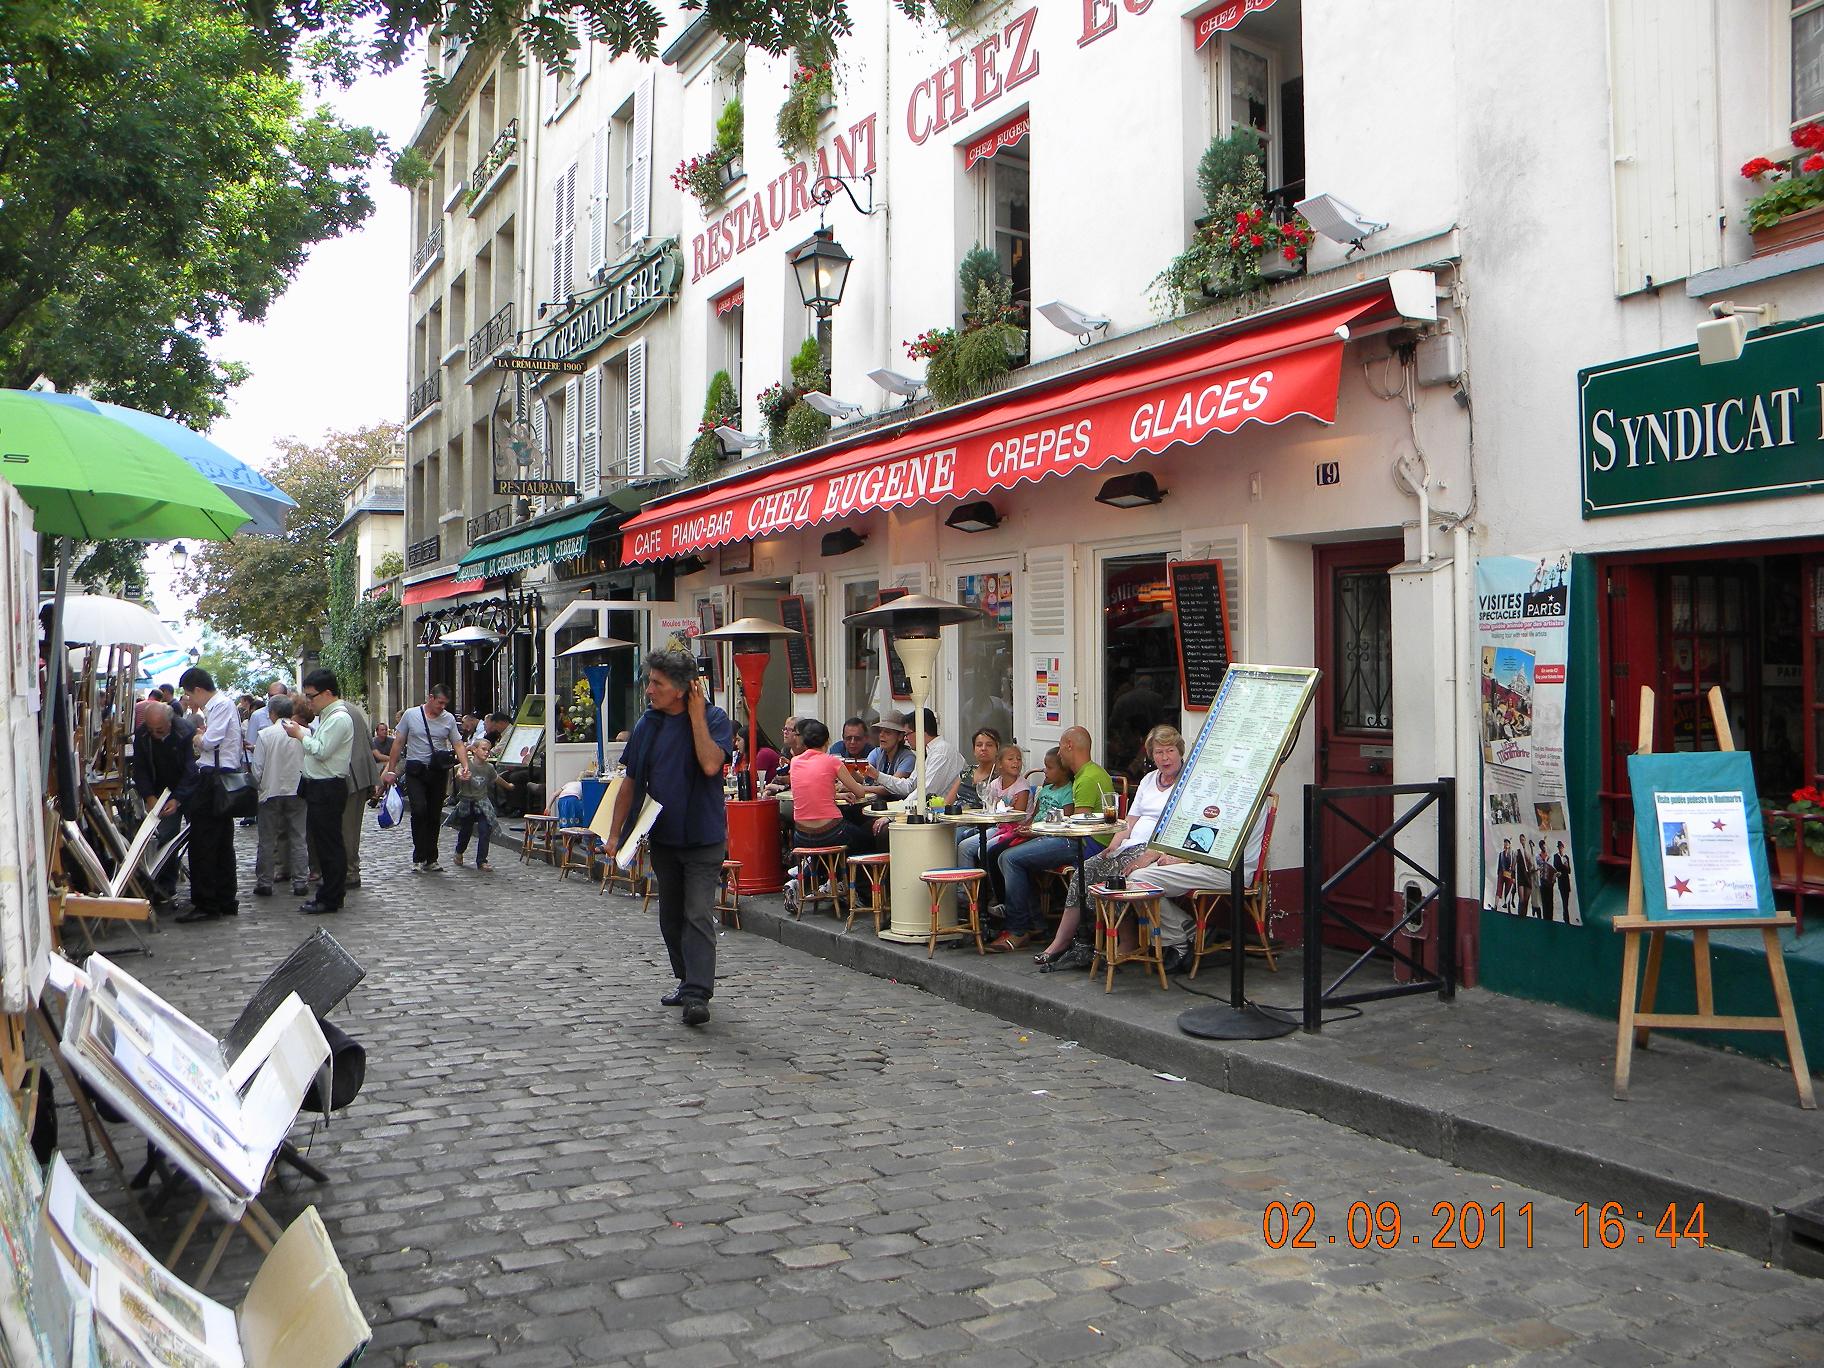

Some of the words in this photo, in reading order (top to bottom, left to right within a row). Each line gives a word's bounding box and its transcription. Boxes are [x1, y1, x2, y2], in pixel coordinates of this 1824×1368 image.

[1200, 6, 1237, 35] CHEZ
[906, 6, 1039, 146] CHEZ
[969, 139, 993, 160] CHEZ
[691, 112, 877, 282] RESTAURANT
[986, 419, 1092, 478] CREPES
[1129, 370, 1274, 443] GLACES
[1592, 387, 1801, 472] SYNDICAT
[1317, 462, 1340, 485] 19
[500, 481, 569, 494] RESTAURANT
[634, 530, 662, 556] CAFE
[671, 510, 733, 548] PIANO-BAR
[747, 484, 815, 532] CHEZ
[822, 447, 957, 516] EUGENE
[1479, 593, 1522, 611] VISITES
[1527, 602, 1561, 616] PARIS
[661, 620, 681, 628] Moules
[1479, 611, 1521, 621] SPECTACLES
